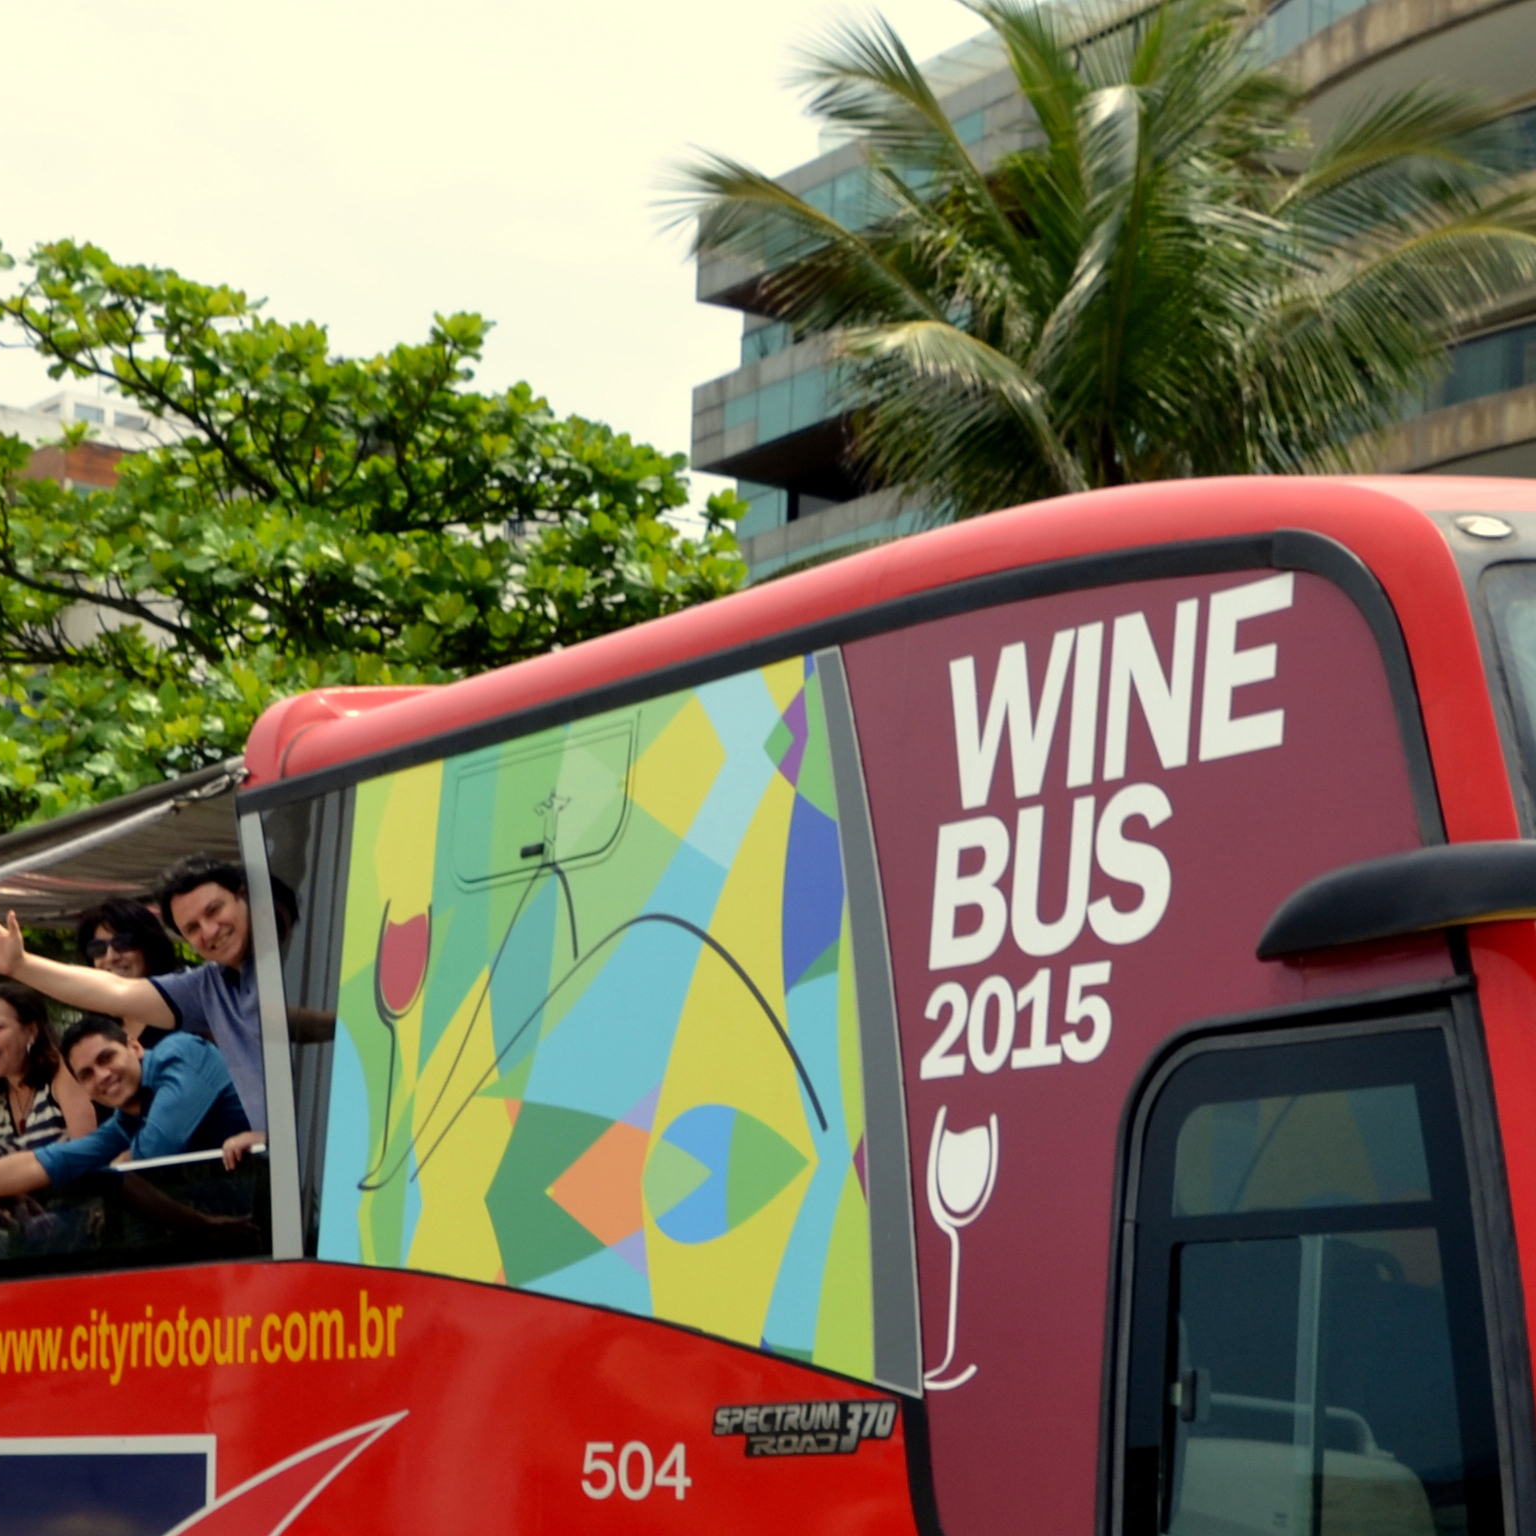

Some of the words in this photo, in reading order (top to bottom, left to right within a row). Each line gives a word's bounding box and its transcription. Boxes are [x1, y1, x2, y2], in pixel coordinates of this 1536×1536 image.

[949, 571, 1294, 810] WINE
[929, 783, 1172, 971] BUS
[920, 960, 1112, 1080] 2015
[581, 1441, 692, 1500] 504
[714, 1402, 841, 1435] SPECTRUM
[838, 1401, 897, 1453] 370
[748, 1432, 839, 1455] ROAD
